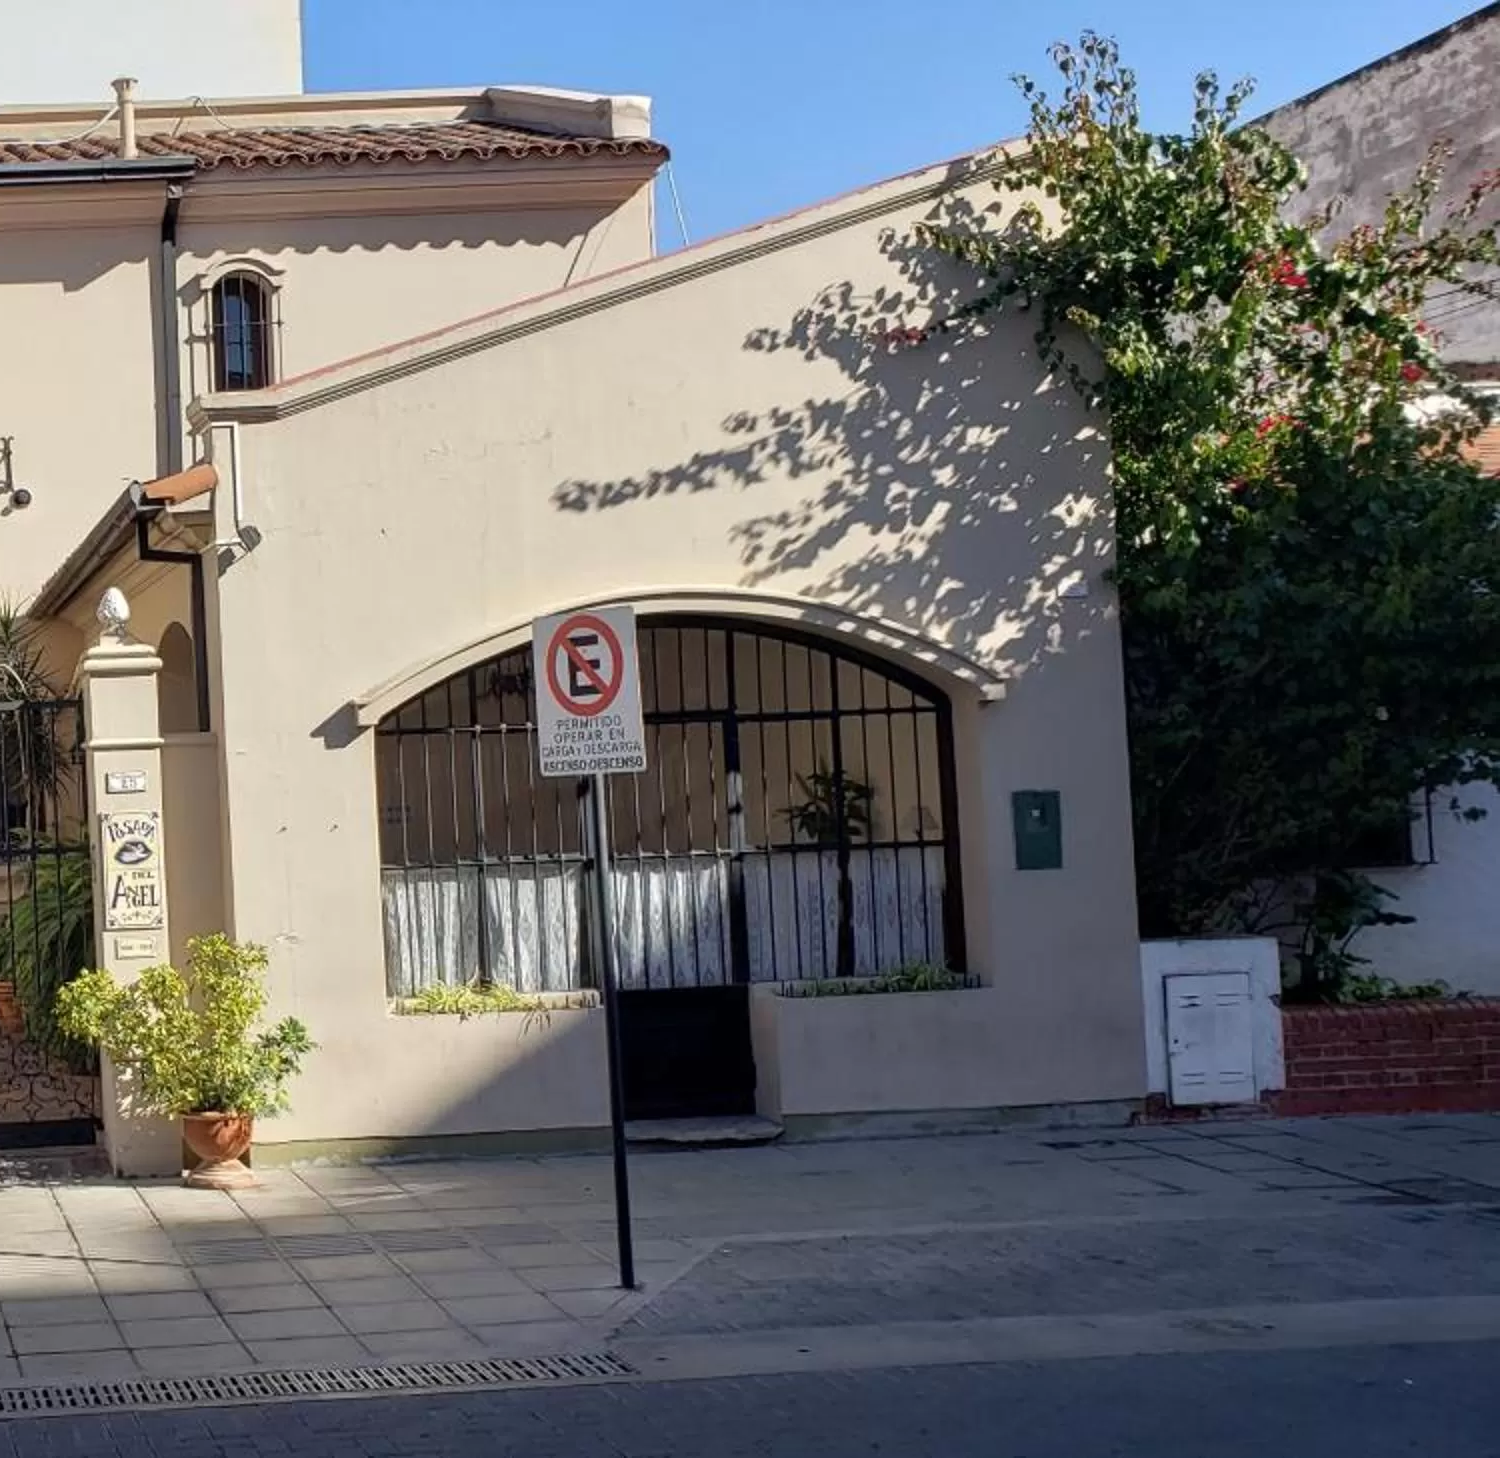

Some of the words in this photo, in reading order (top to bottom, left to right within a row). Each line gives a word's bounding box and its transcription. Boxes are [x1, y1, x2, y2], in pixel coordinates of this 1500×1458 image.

[567, 634, 605, 696] E
[556, 715, 622, 731] PERMITIDO
[553, 730, 602, 744] OPERAR
[609, 727, 625, 741] EN
[542, 745, 575, 757] CARGA
[584, 741, 641, 755] DESCARGA
[108, 820, 155, 843] POSADA
